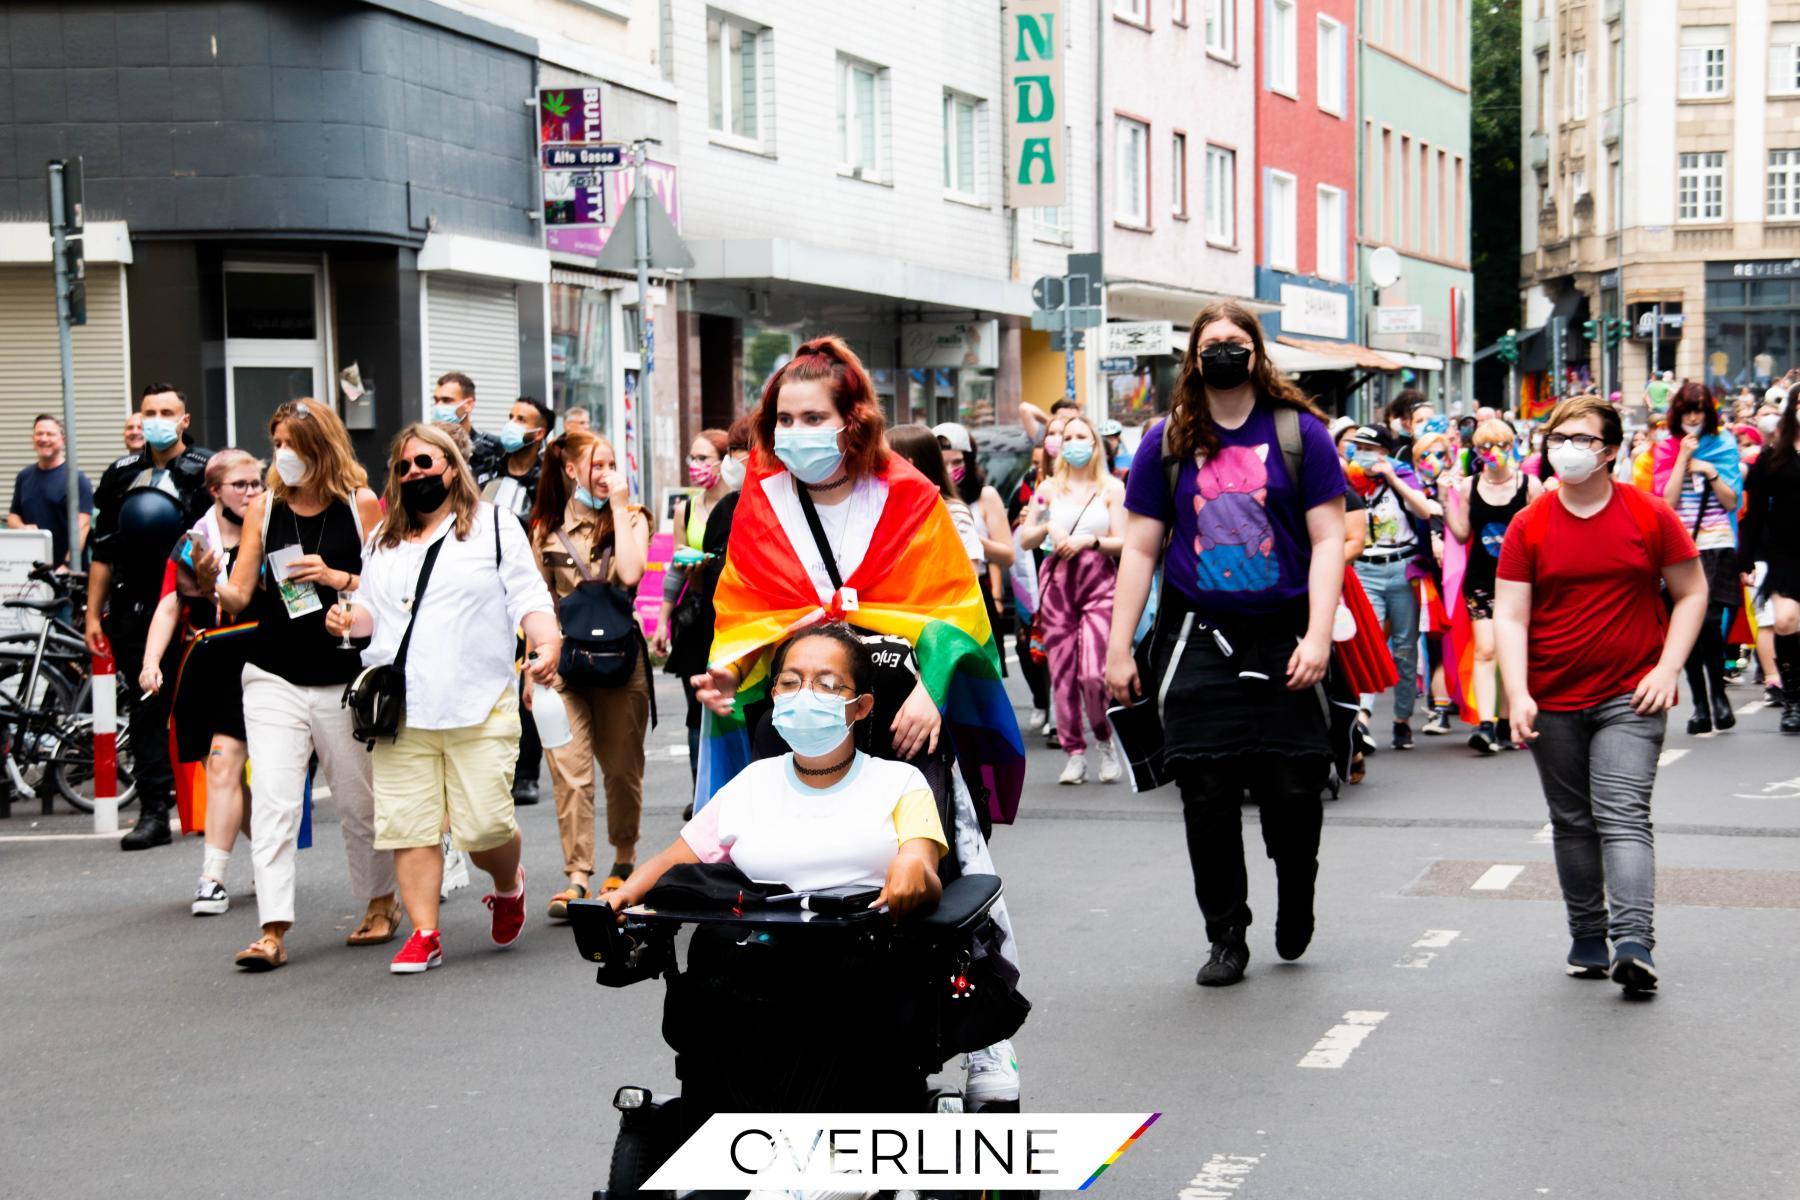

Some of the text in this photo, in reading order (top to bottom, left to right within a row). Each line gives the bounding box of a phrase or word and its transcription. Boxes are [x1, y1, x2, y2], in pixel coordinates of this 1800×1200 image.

[1014, 0, 1055, 185] NDA
[554, 149, 614, 164] Alte Gasse
[1734, 263, 1791, 276] REVIER
